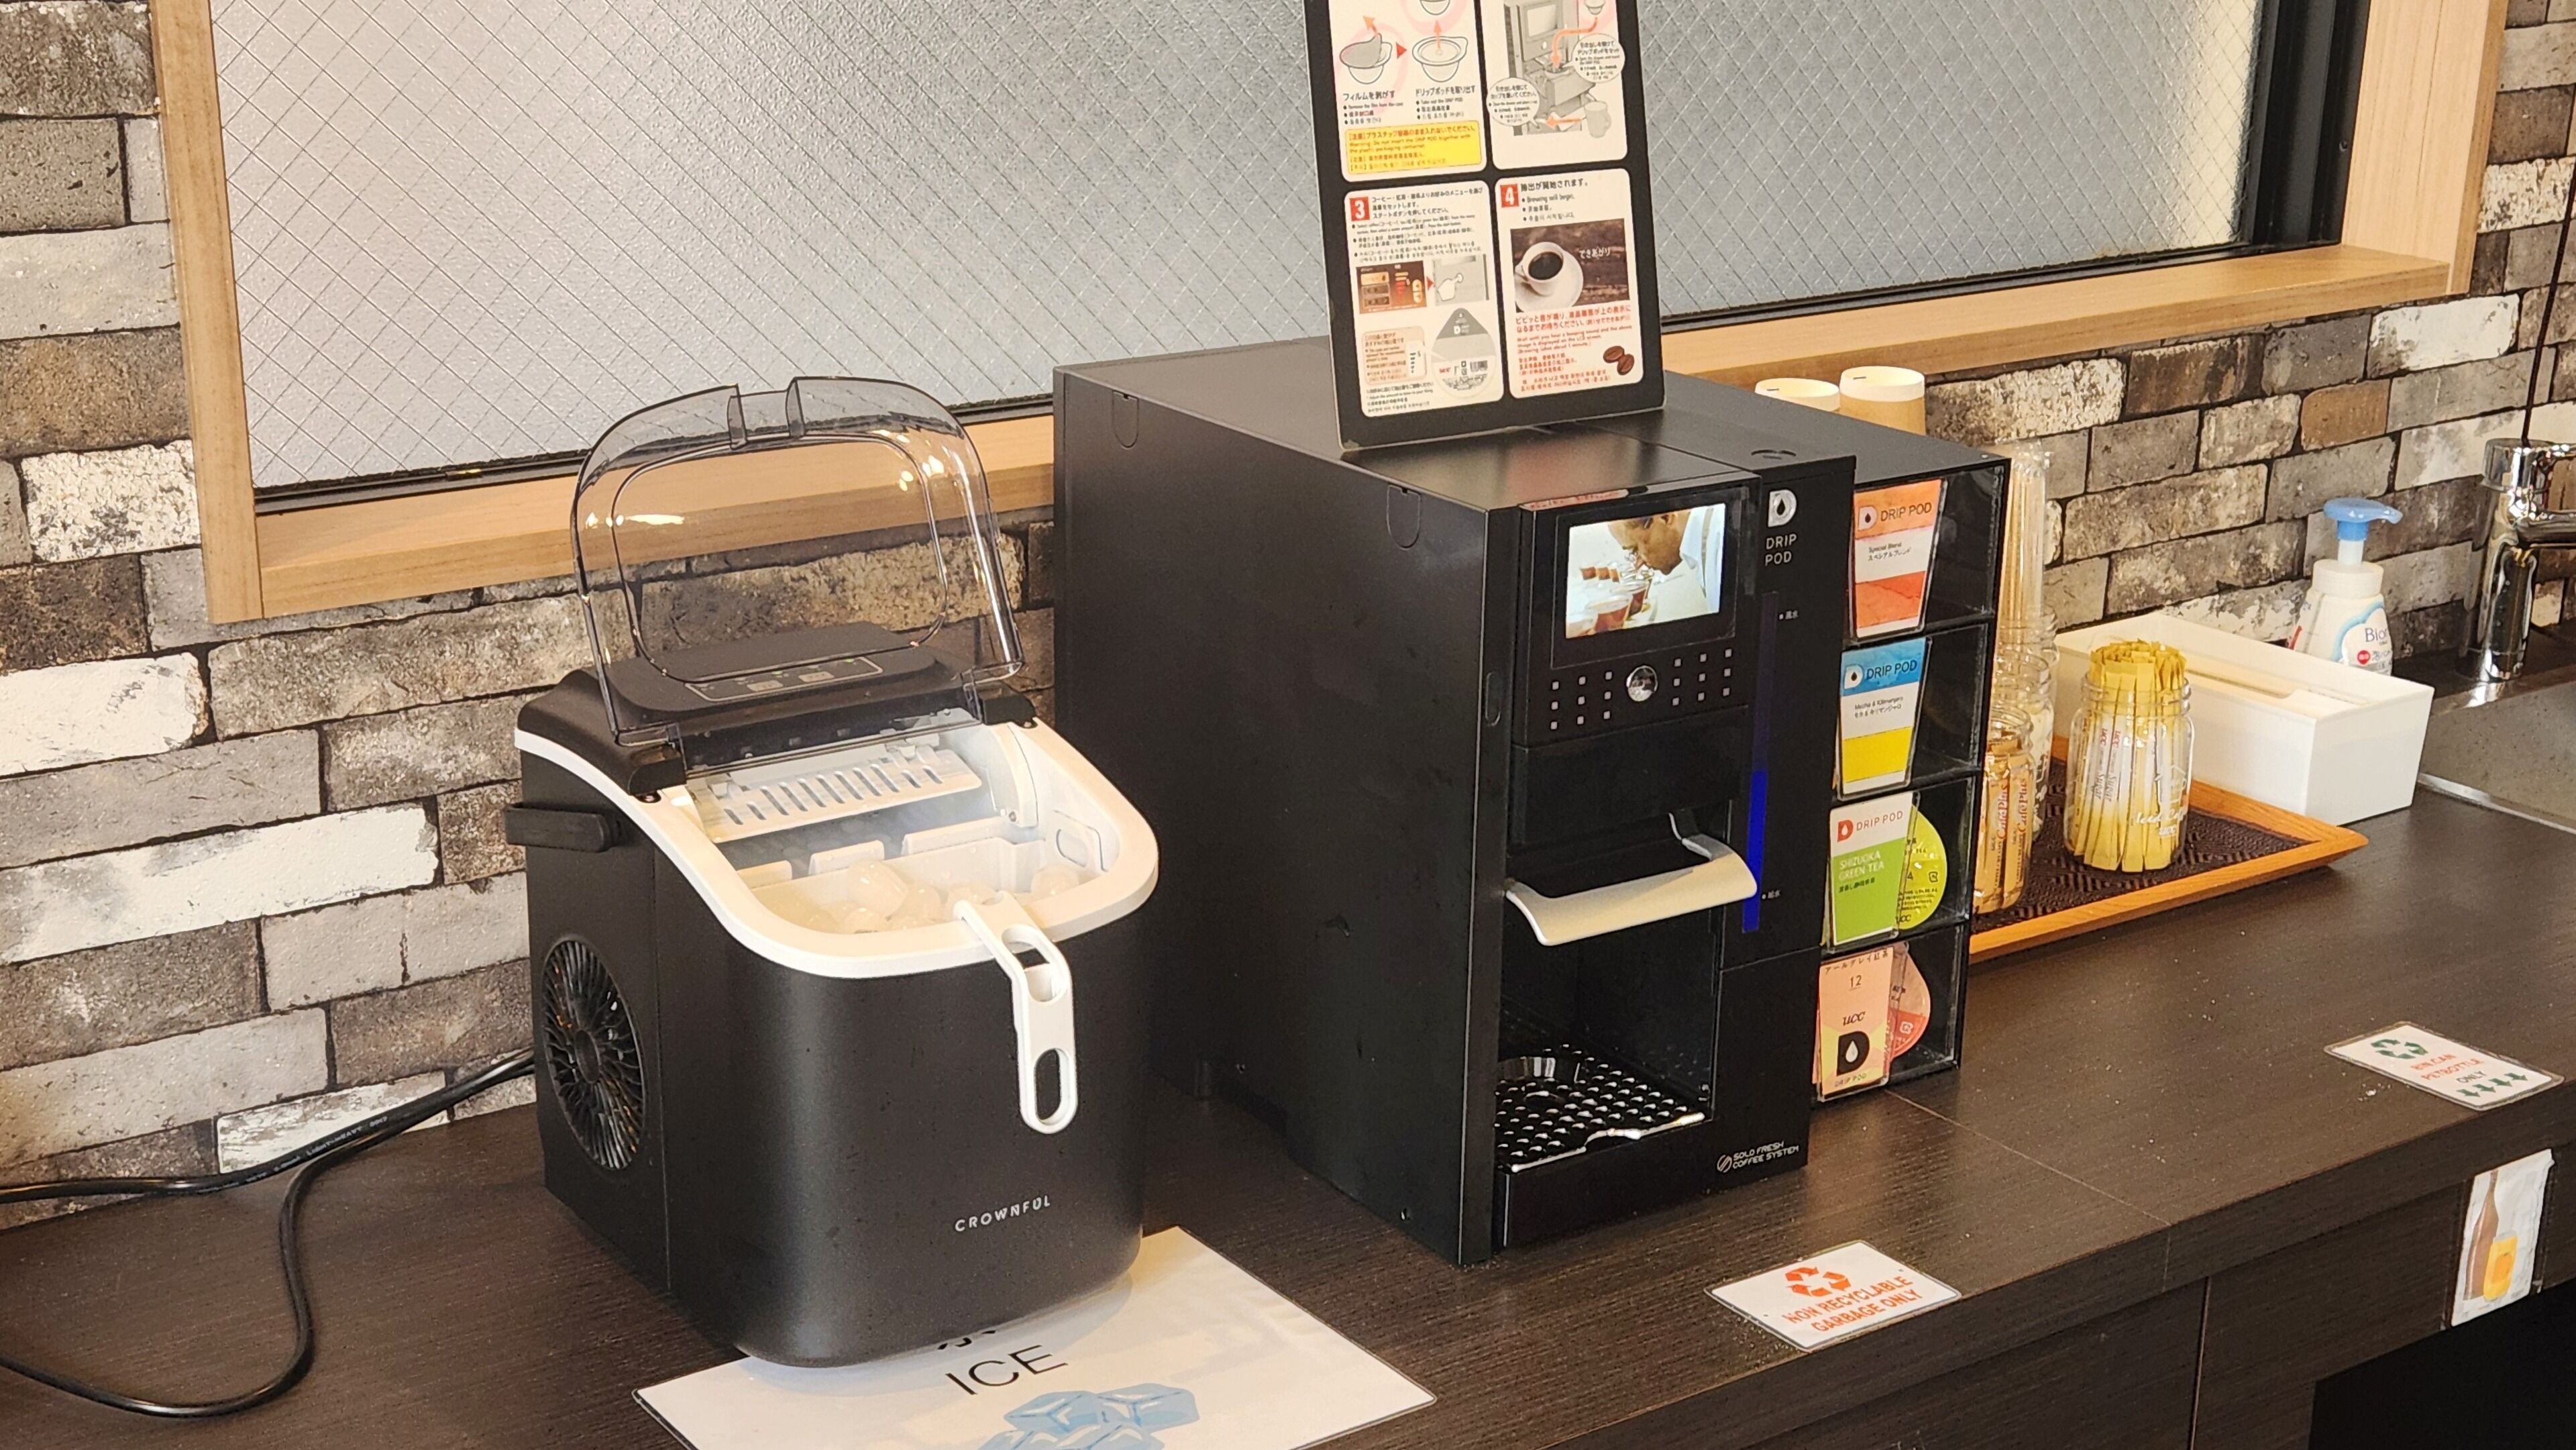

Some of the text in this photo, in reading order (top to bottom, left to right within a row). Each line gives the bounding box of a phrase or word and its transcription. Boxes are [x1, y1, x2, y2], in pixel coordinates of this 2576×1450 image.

[1505, 187, 1515, 205] 4
[1354, 200, 1366, 219] 3
[1578, 246, 1611, 260] できあがり
[1880, 506, 1906, 522] DRIP
[1909, 502, 1932, 517] POD
[1766, 533, 1797, 550] DRIP
[1765, 551, 1792, 567] POD
[1866, 664, 1892, 680] DRIP
[1894, 660, 1917, 675] POD
[1856, 817, 1880, 832] DRIP
[1882, 811, 1903, 825] POD
[1839, 850, 1881, 870] SHIZUOKA
[1839, 862, 1884, 881] GREEN TEA
[1850, 975, 1862, 988] 12
[1835, 1073, 1867, 1087] DRIP POD
[2456, 1070, 2486, 1084] ONLY
[1733, 1141, 1784, 1161] SOLO FRESH
[1733, 1145, 1799, 1169] COFFEE SYSTEM
[955, 1194, 1051, 1232] CROWNFUL
[1782, 1276, 1913, 1324] NON RECYCLABLE
[1811, 1288, 1923, 1332] GARBAGE ONLY
[945, 1344, 1069, 1395] ICE
